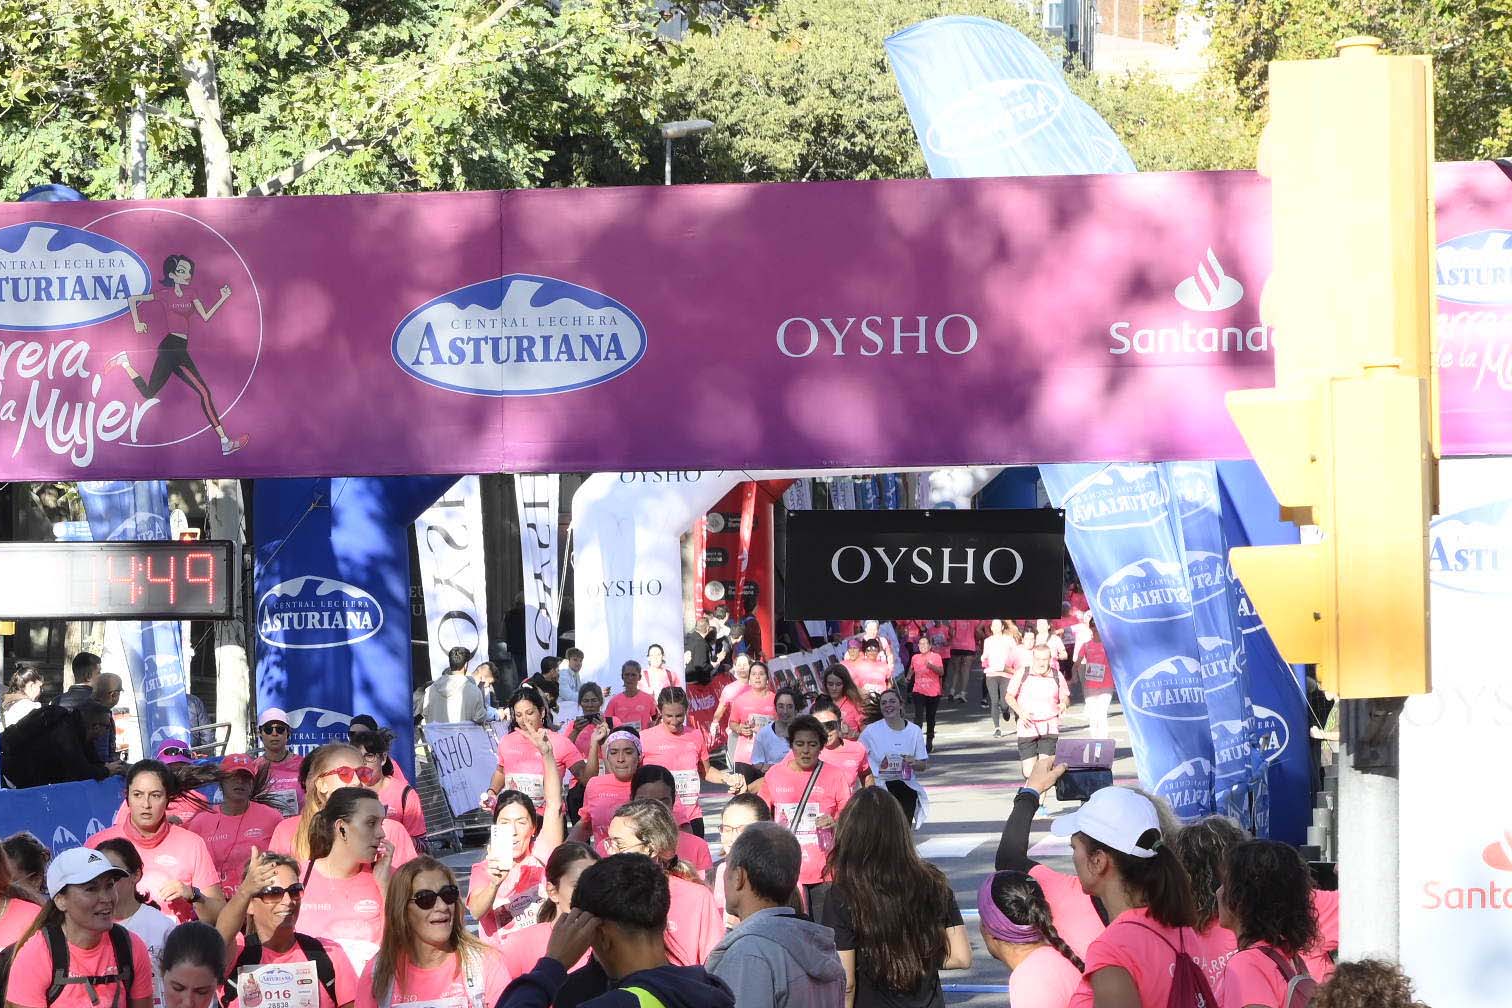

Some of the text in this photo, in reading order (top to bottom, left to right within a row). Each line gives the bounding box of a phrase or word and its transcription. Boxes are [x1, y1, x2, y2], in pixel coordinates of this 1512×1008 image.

[54, 258, 126, 270] LECHERA
[451, 314, 619, 330] CENTRAL LECHERA
[775, 314, 979, 358] OYSHO
[411, 321, 627, 365] ASTURIANA
[1109, 322, 1273, 355] Santand
[11, 373, 161, 468] Mujer
[830, 545, 1024, 586] OYSHO
[585, 579, 663, 598] OYSHO
[273, 599, 369, 610] CENTRAL LECHERA
[261, 605, 374, 633] ASTURIANA
[264, 989, 292, 1000] 016
